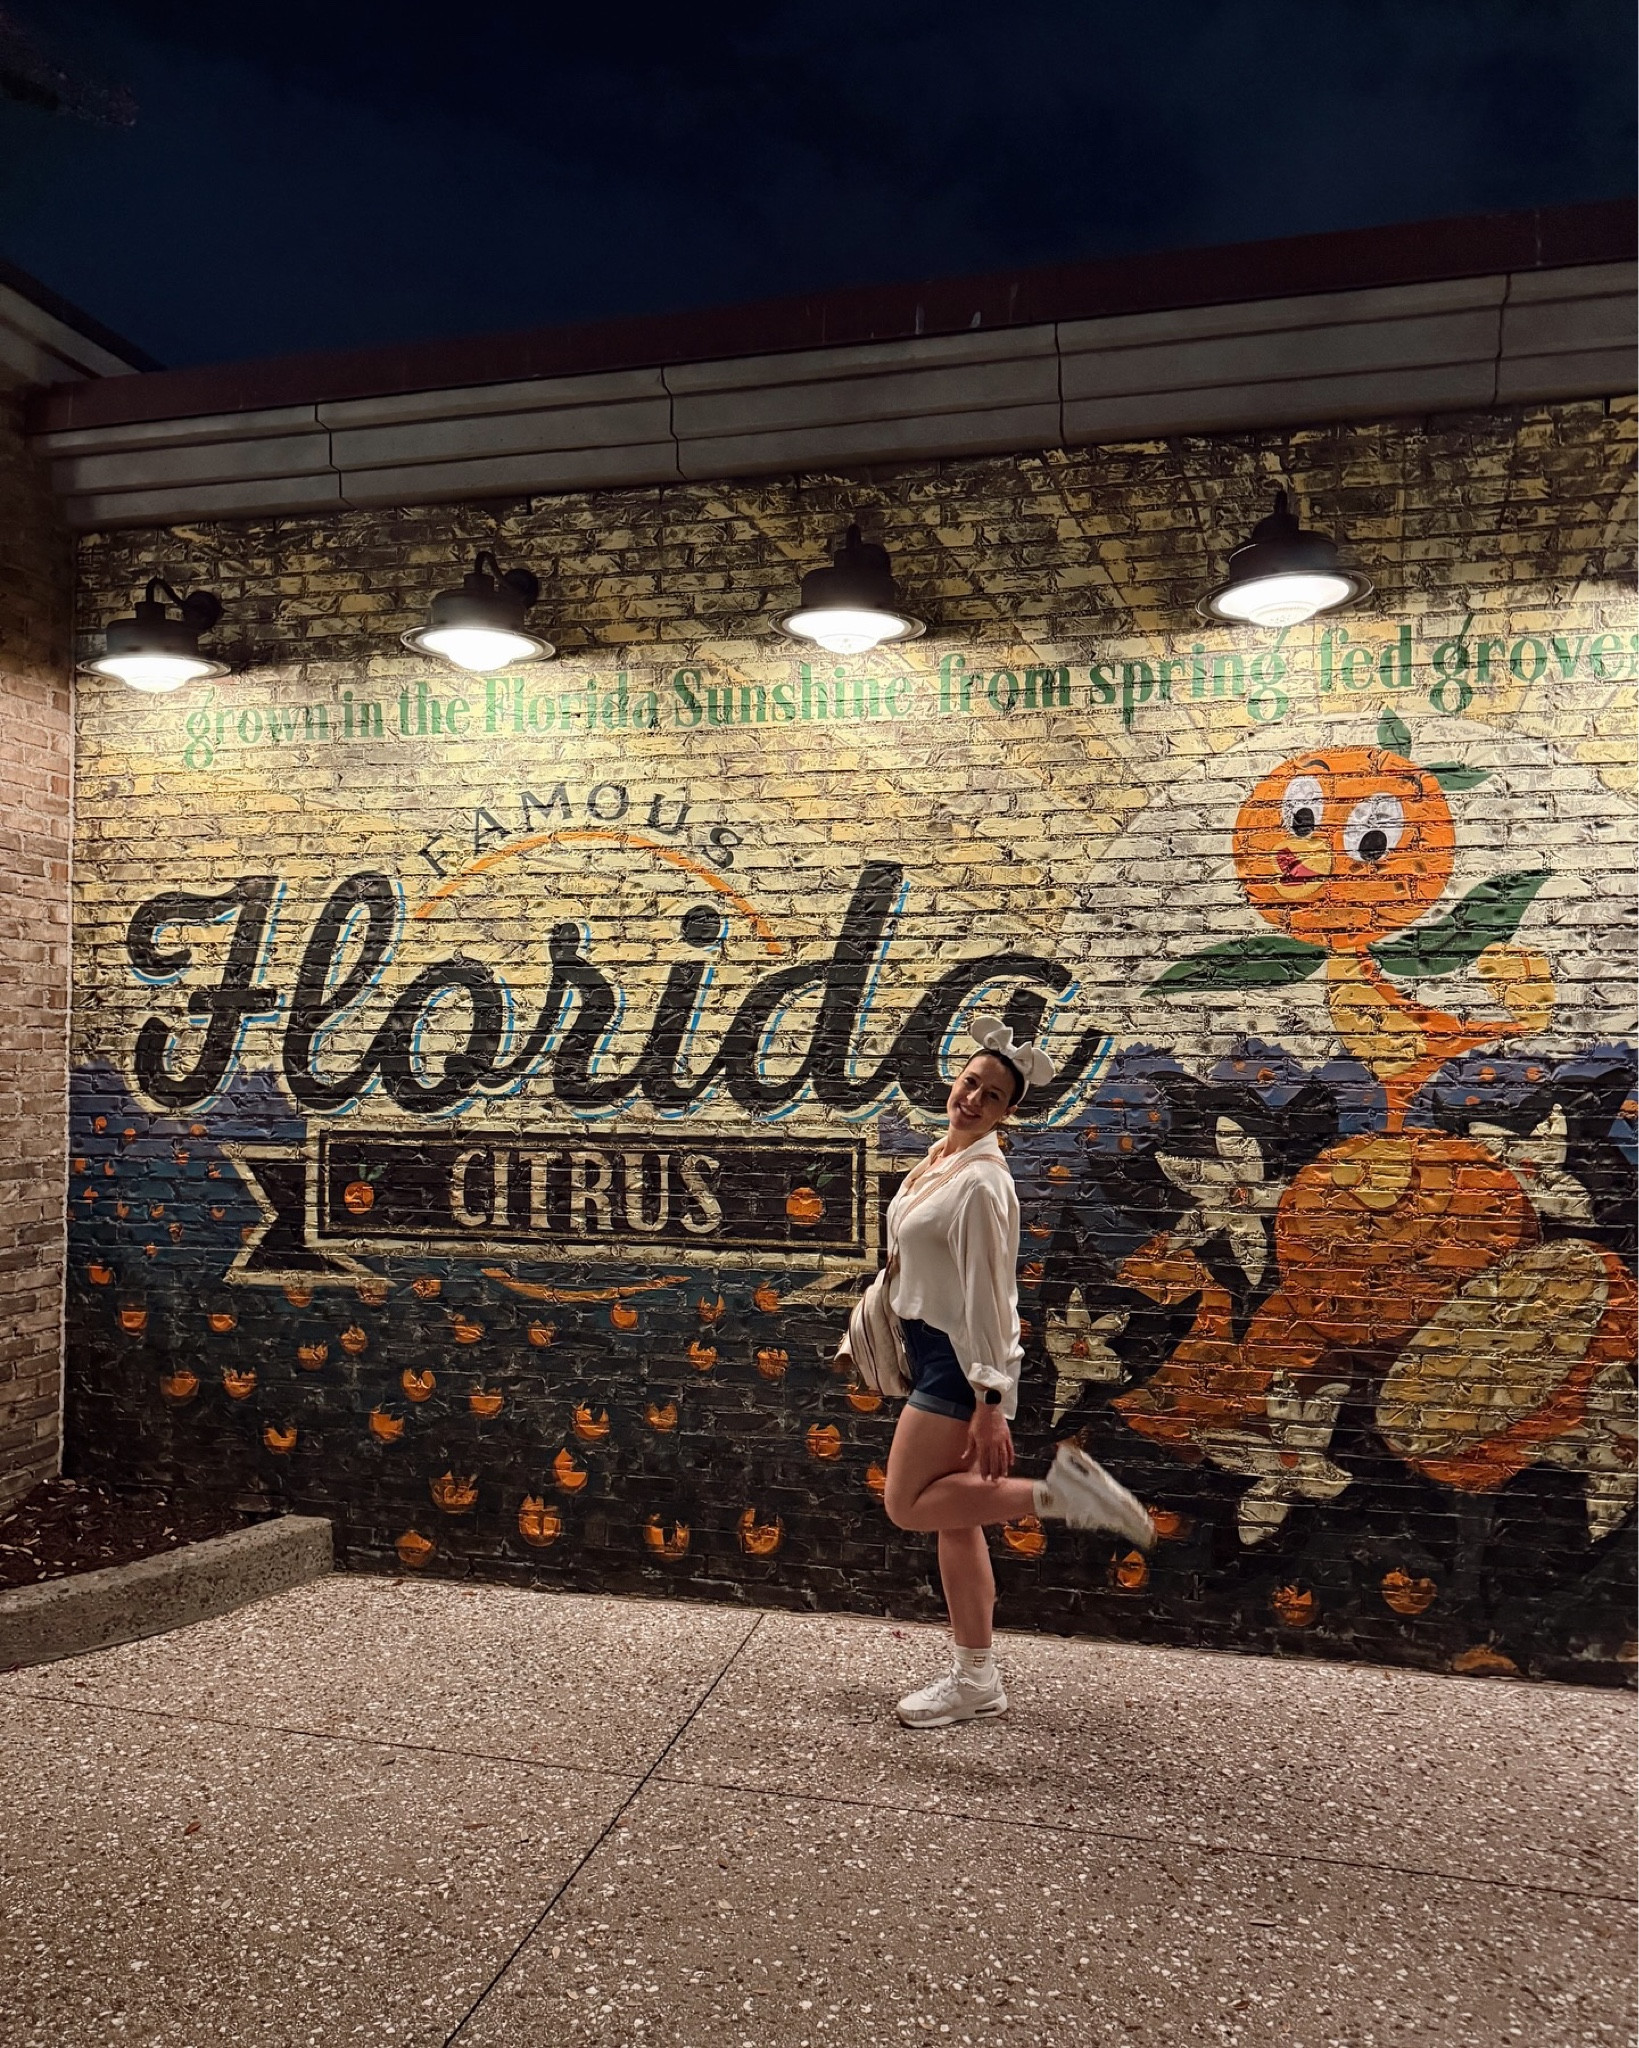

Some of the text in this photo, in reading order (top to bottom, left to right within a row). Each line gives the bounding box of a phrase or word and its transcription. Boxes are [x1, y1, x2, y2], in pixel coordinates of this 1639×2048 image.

[183, 686, 328, 770] grown
[343, 691, 386, 738] in
[400, 680, 471, 736] the
[483, 671, 659, 734] Florida
[673, 661, 913, 727] Sunshine
[938, 653, 1074, 714] from
[1088, 625, 1291, 730] spring
[1319, 625, 1415, 693] fed
[418, 783, 744, 877] FAMOUS
[126, 858, 1108, 1118] Florida
[450, 1147, 722, 1236] CITRUS
